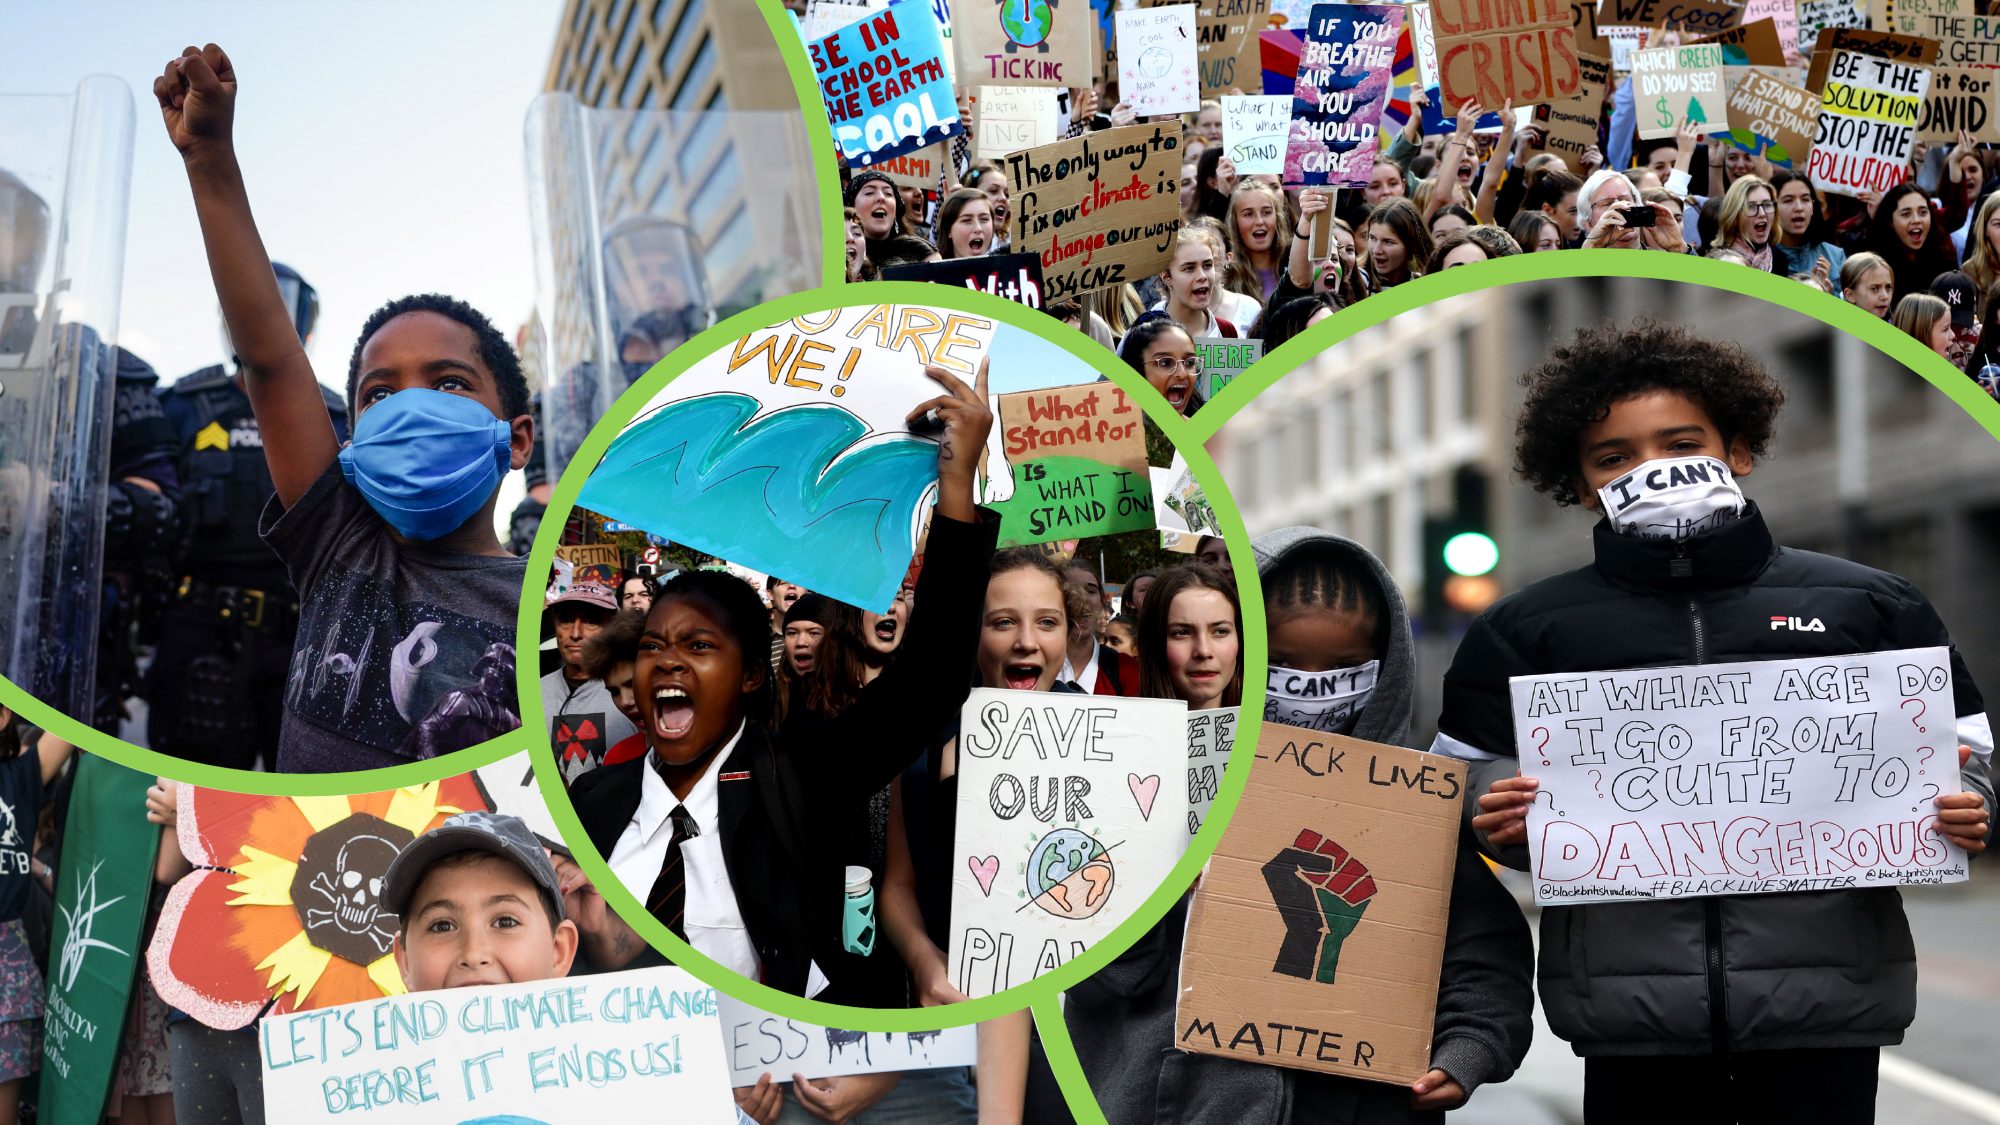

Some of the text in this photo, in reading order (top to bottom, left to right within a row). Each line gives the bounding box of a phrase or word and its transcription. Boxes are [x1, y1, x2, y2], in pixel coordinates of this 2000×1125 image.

[1125, 14, 1180, 29] MAKE EARTH
[1750, 0, 1792, 16] HUGE
[859, 10, 900, 52] IN
[1139, 33, 1165, 46] COOL
[1198, 24, 1227, 43] AN
[1318, 18, 1395, 42] IF YOU
[1928, 15, 1966, 38] THE
[984, 54, 1063, 82] TICKING
[1305, 41, 1393, 68] BREATHE
[1441, 27, 1580, 109] CRISIS
[1632, 50, 1676, 74] WHICH
[1679, 48, 1722, 69] GREEN
[1832, 51, 1923, 93] BE THE
[867, 56, 945, 108] EARTH
[1300, 68, 1331, 88] AIR
[1642, 77, 1661, 96] DO
[1661, 73, 1687, 93] YOU
[1689, 71, 1717, 93] SEE?
[1741, 72, 1759, 92] I
[1755, 78, 1803, 110] STAND
[1802, 97, 1821, 118] FO
[1936, 73, 1990, 93] it for
[1228, 99, 1265, 115] What
[1270, 101, 1274, 117] I
[1315, 92, 1354, 116] YOU
[1730, 90, 1771, 118] WHAT
[1766, 104, 1780, 123] I
[1823, 83, 1919, 121] SOLUTION
[1918, 96, 1987, 133] DAVID
[836, 92, 959, 160] COOL
[1231, 117, 1243, 130] is
[1299, 122, 1376, 143] SHOULD
[1813, 112, 1914, 159] STOP THE
[1008, 128, 1177, 192] The only way to
[1232, 144, 1278, 163] STAND
[1302, 151, 1351, 174] CARE
[1549, 136, 1586, 155] carin
[1807, 149, 1909, 194] POLLUTION
[1019, 171, 1176, 240] fix our climate is
[1042, 218, 1180, 267] change our ways
[966, 266, 1041, 309] With
[1947, 288, 1961, 305] NY
[846, 304, 992, 375] ARE
[727, 333, 862, 397] WE!
[1027, 388, 1132, 423] What I
[230, 428, 263, 447] POL
[1006, 420, 1137, 456] Stand for
[1038, 473, 1100, 502] WHAT
[1112, 471, 1135, 495] I
[1611, 460, 1728, 511] I CAN'T
[1029, 500, 1106, 536] STAND
[570, 546, 618, 568] GETTIN
[1770, 616, 1826, 632] FILA
[1285, 670, 1364, 697] CAN'T
[1528, 663, 1948, 718] AT WHAT AGE DO
[966, 700, 1118, 761] SAVE
[1565, 716, 1606, 766] I
[1614, 720, 1693, 764] GO
[1721, 711, 1877, 757] FROM
[1255, 741, 1459, 800] ACK LIVES
[1611, 758, 1794, 812] CUTE
[1834, 754, 1911, 803] TO
[989, 772, 1094, 823] OUR
[1538, 814, 1948, 882] DANGEROUS
[960, 926, 1087, 998] PLA
[263, 985, 718, 1070] LET'S END CLIMATE CHANGE
[1182, 1018, 1375, 1067] MATTER
[321, 1034, 683, 1114] BEFORE IT ENDS US!
